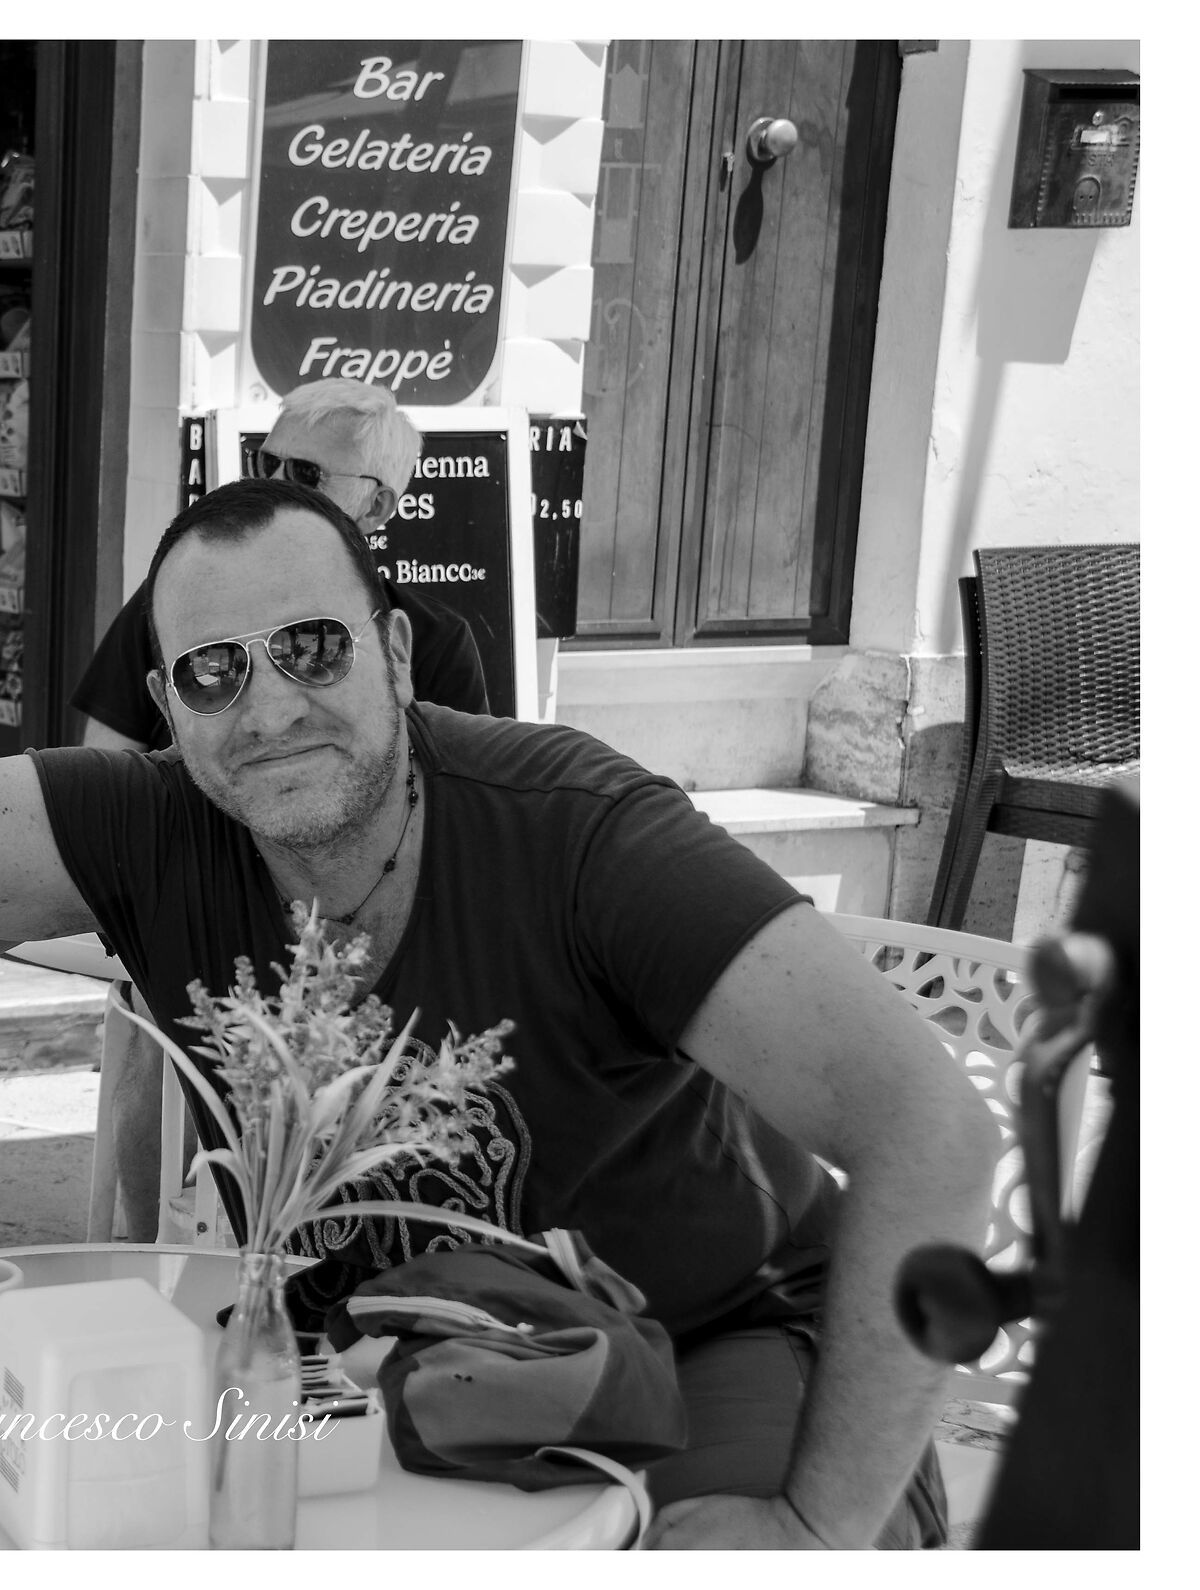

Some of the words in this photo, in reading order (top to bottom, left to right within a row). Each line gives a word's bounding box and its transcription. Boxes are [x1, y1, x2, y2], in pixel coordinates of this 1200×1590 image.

[353, 56, 445, 101] Bar
[288, 124, 492, 175] Gelateria
[290, 196, 480, 253] Creperia
[263, 264, 494, 314] Piadineria
[299, 337, 453, 391] Frappè
[390, 493, 435, 520] es
[540, 499, 583, 521] 2,50
